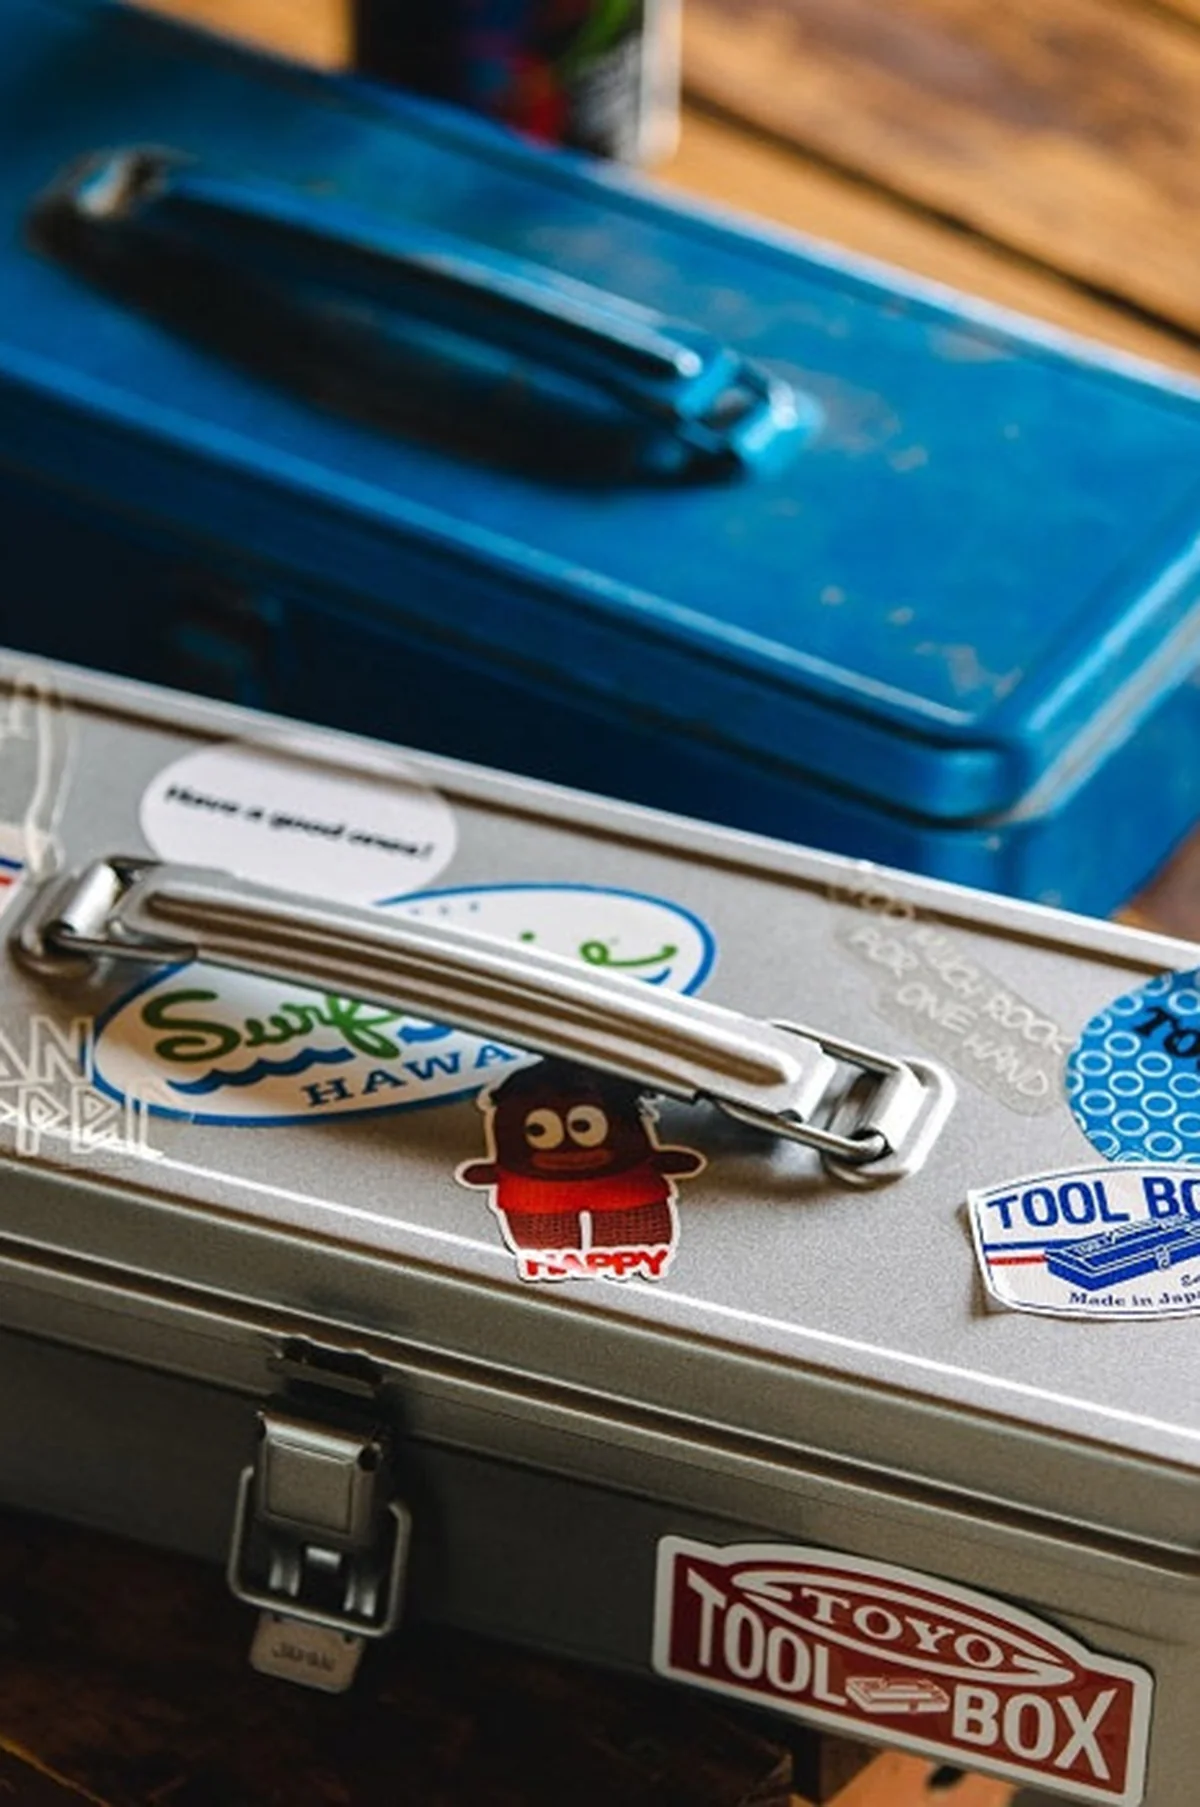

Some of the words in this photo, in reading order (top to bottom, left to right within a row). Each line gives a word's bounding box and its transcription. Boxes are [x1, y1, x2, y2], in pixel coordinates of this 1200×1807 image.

[897, 981, 979, 1035] ONE
[983, 990, 1074, 1056] ROCK
[986, 1180, 1131, 1230] TOOL
[525, 1248, 669, 1278] HAPPY
[1069, 1292, 1125, 1307] Made
[1131, 1294, 1153, 1307] in
[801, 1587, 1002, 1669] TOYO
[686, 1567, 847, 1706] TOOL
[952, 1684, 1117, 1781] BOX
